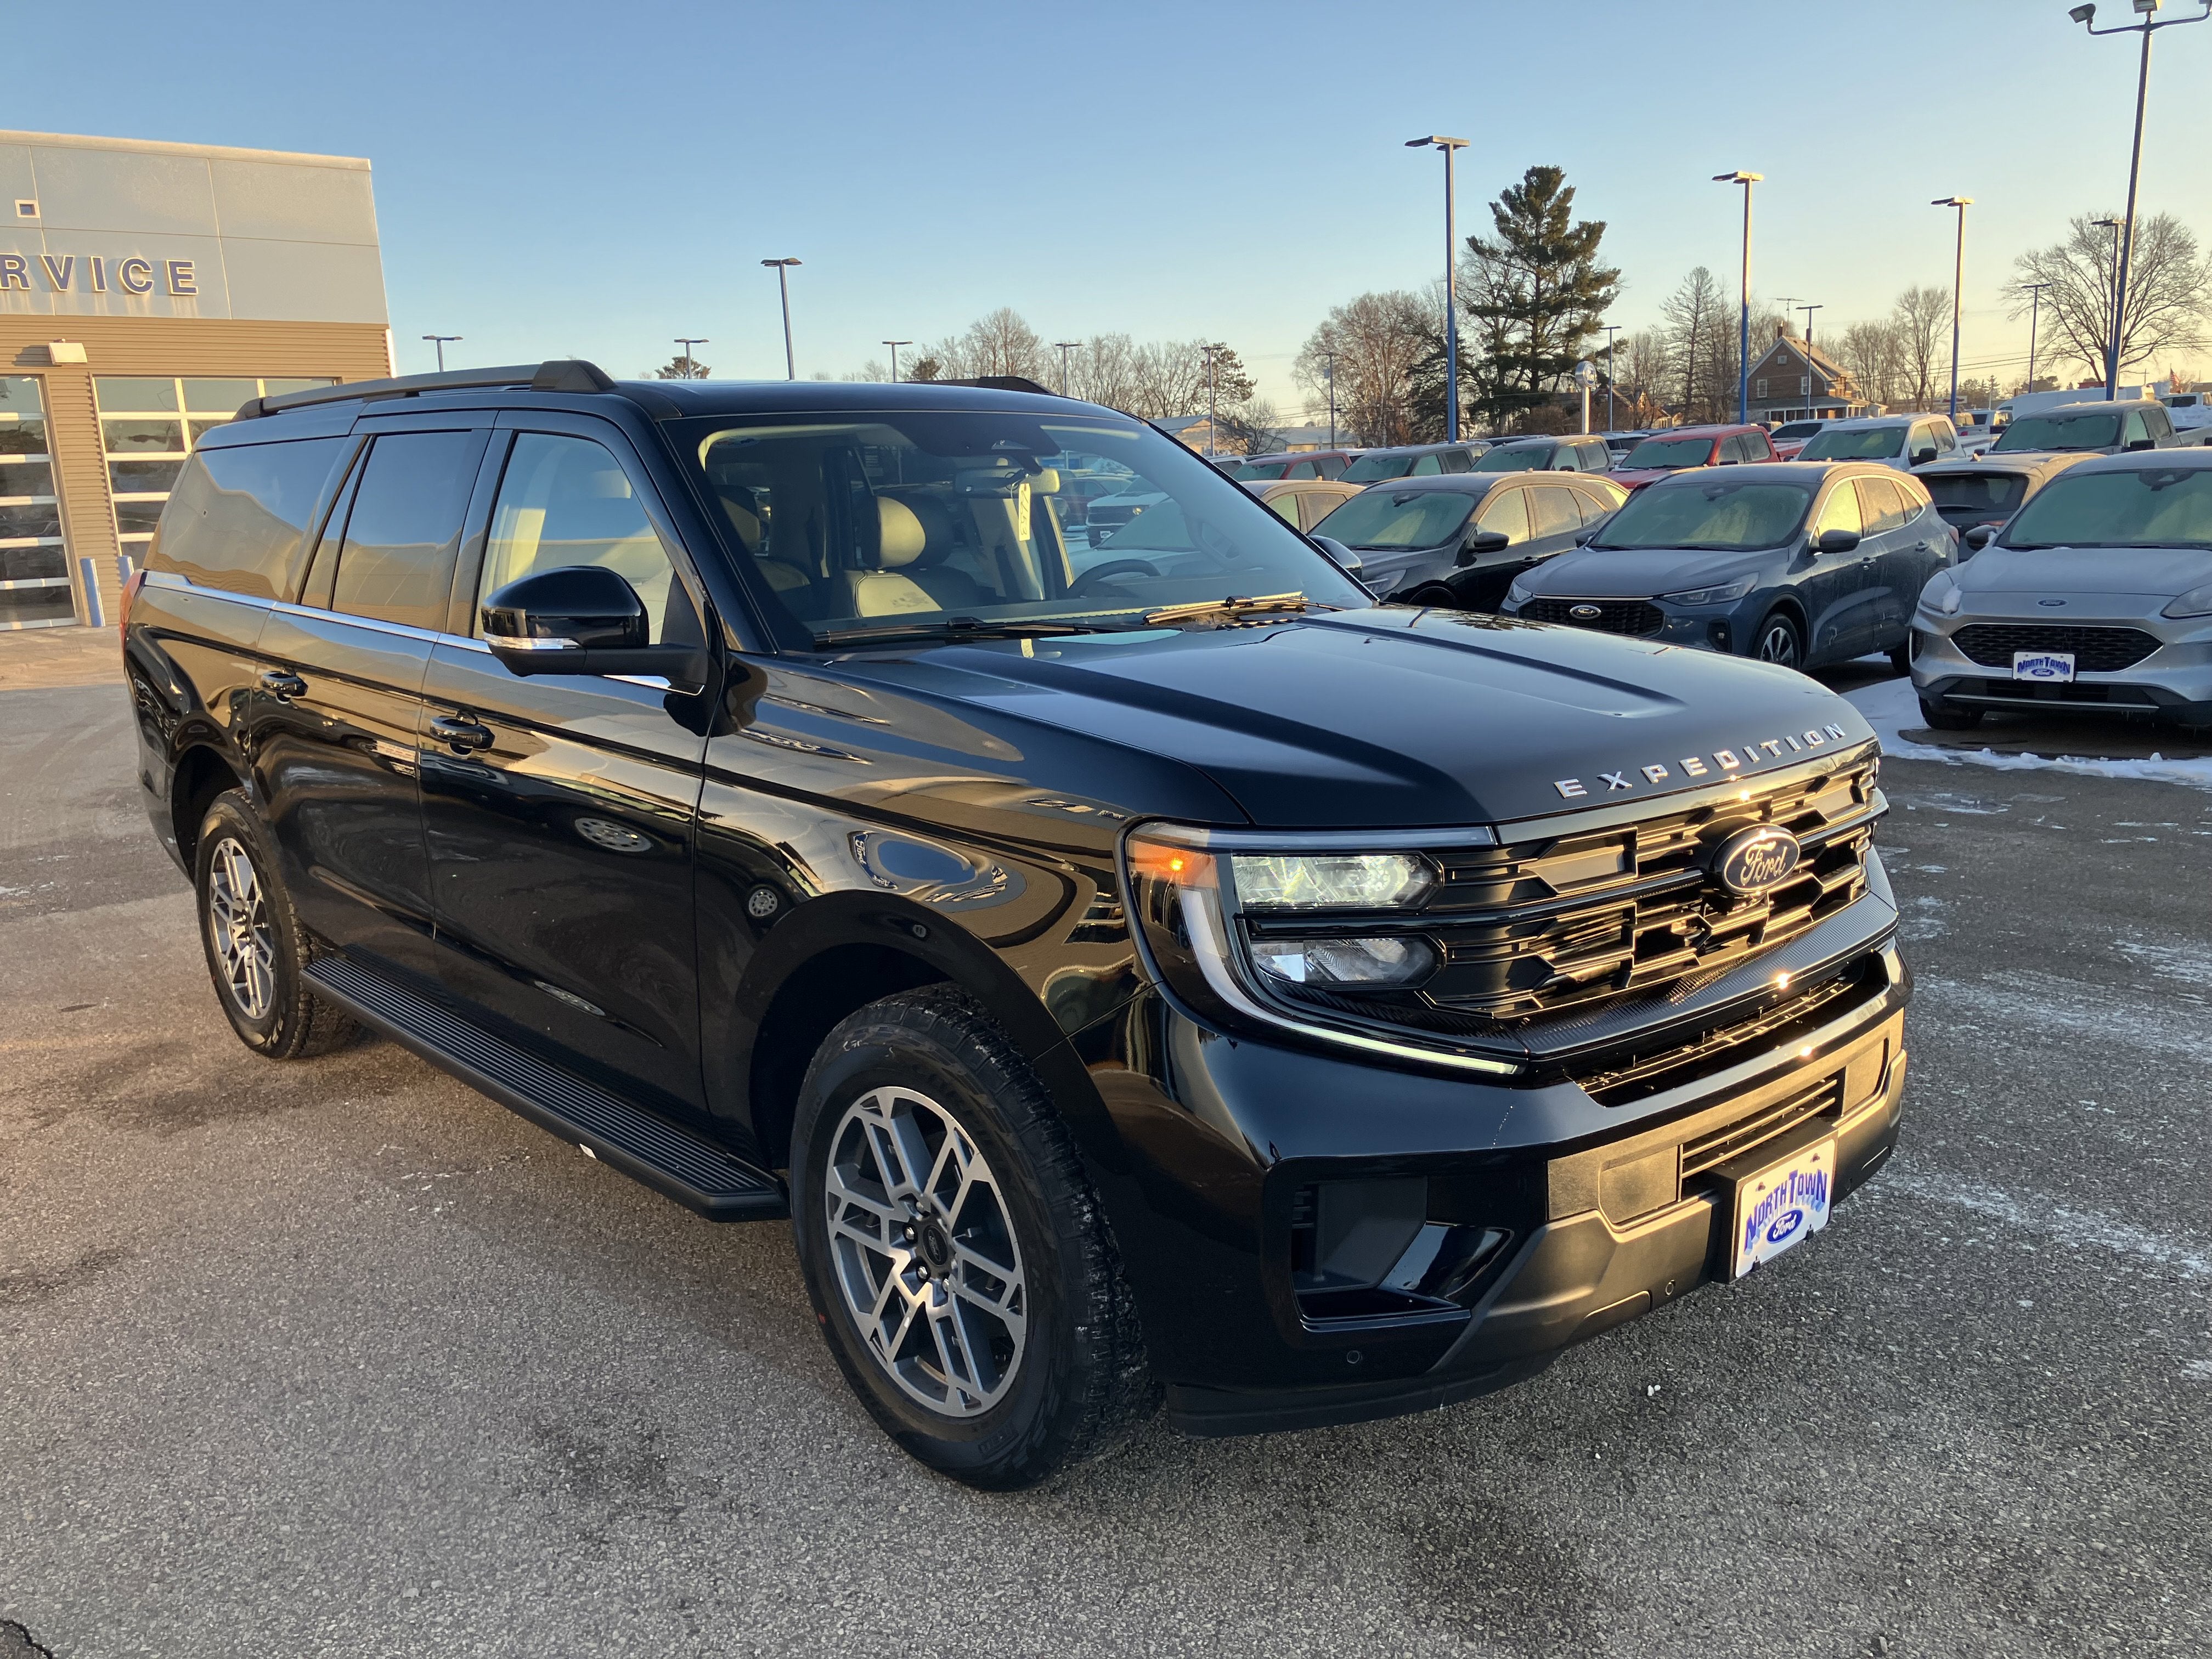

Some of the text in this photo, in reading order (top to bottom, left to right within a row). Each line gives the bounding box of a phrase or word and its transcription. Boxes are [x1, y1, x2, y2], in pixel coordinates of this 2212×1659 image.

[0, 253, 199, 295] RVICE
[1554, 723, 1846, 799] EXPEDITION
[1740, 840, 1788, 887] Ford
[1773, 1213, 1797, 1239] Ford
